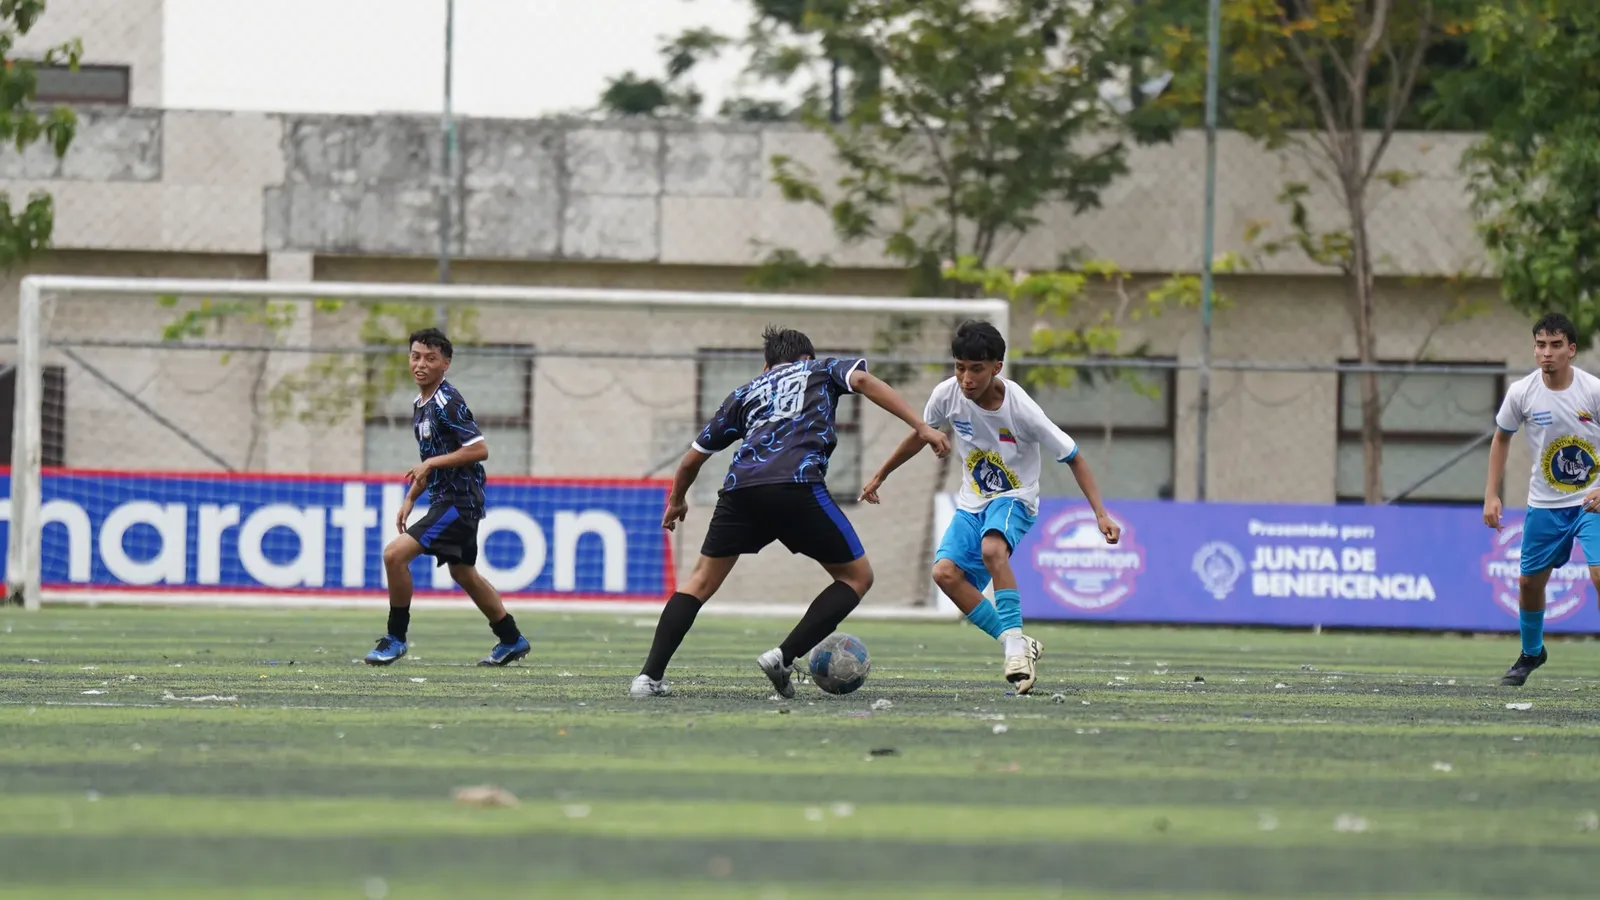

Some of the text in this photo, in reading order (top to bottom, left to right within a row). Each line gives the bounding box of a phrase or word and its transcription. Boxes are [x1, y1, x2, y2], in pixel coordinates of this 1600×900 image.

[1248, 518, 1375, 540] Presentado por:
[1037, 549, 1140, 569] marathon
[1251, 545, 1376, 572] JUNTA DE
[1252, 572, 1436, 600] BENEFICENCIA
